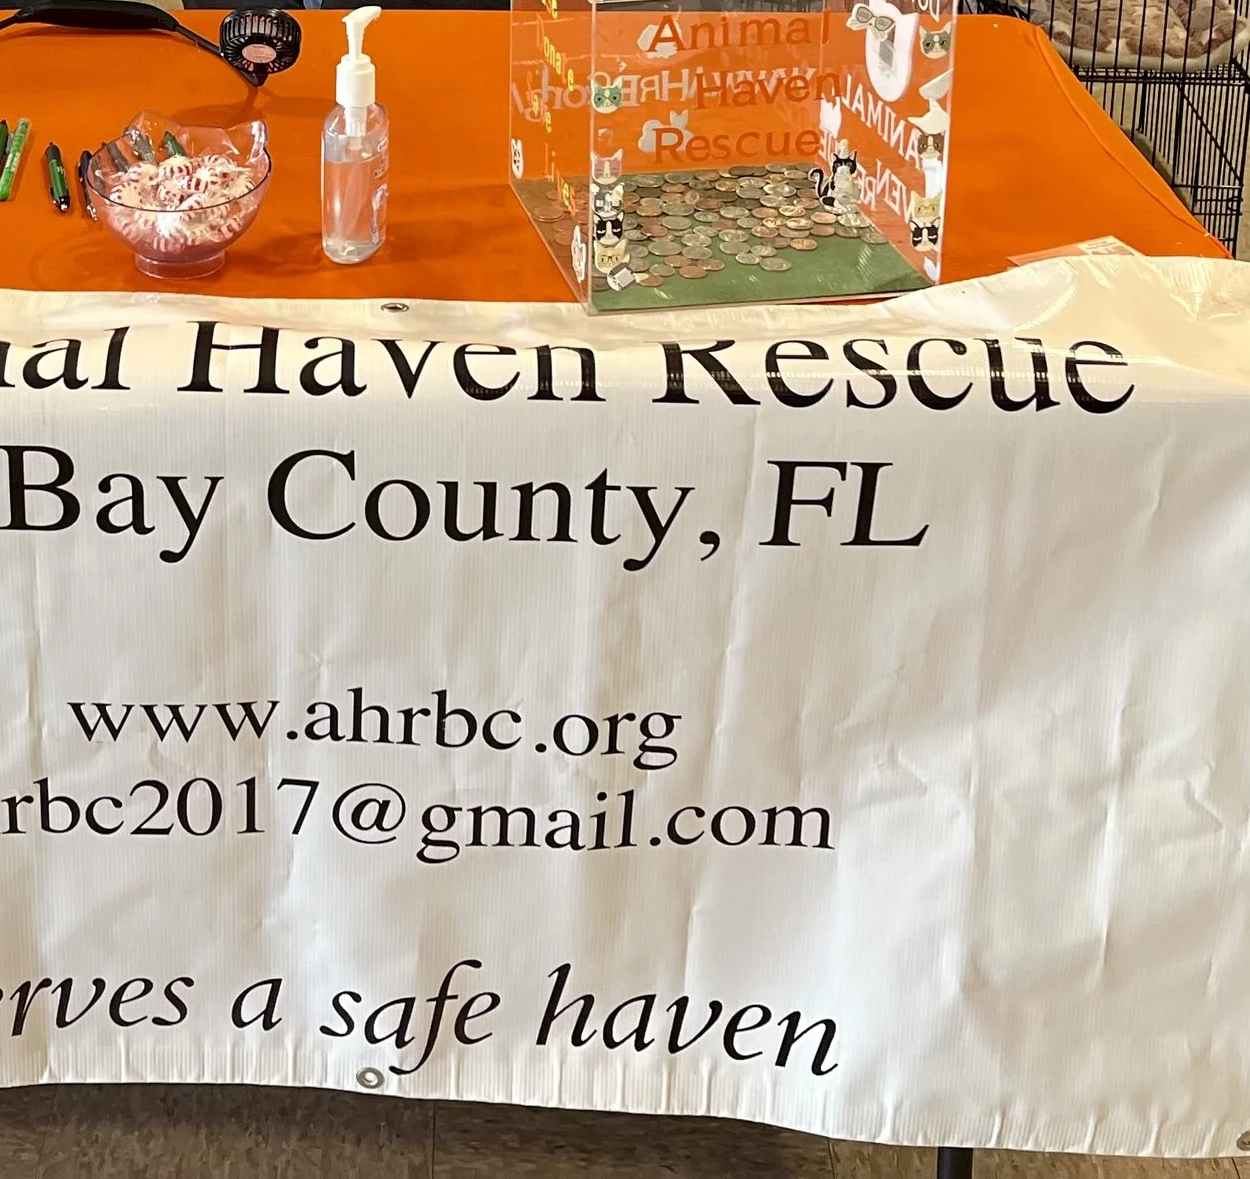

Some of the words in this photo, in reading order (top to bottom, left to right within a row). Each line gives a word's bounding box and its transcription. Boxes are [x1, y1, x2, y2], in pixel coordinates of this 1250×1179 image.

[647, 8, 830, 53] Animal
[693, 68, 841, 110] Haven
[653, 128, 823, 164] Rescue
[177, 320, 606, 401] Haven
[652, 338, 1135, 413] Rescue
[267, 449, 721, 571] County,
[758, 460, 929, 546] FL
[67, 688, 682, 770] www.ahrbc.org
[231, 978, 283, 1031] a
[319, 959, 501, 1075] safe
[536, 963, 839, 1076] haven
